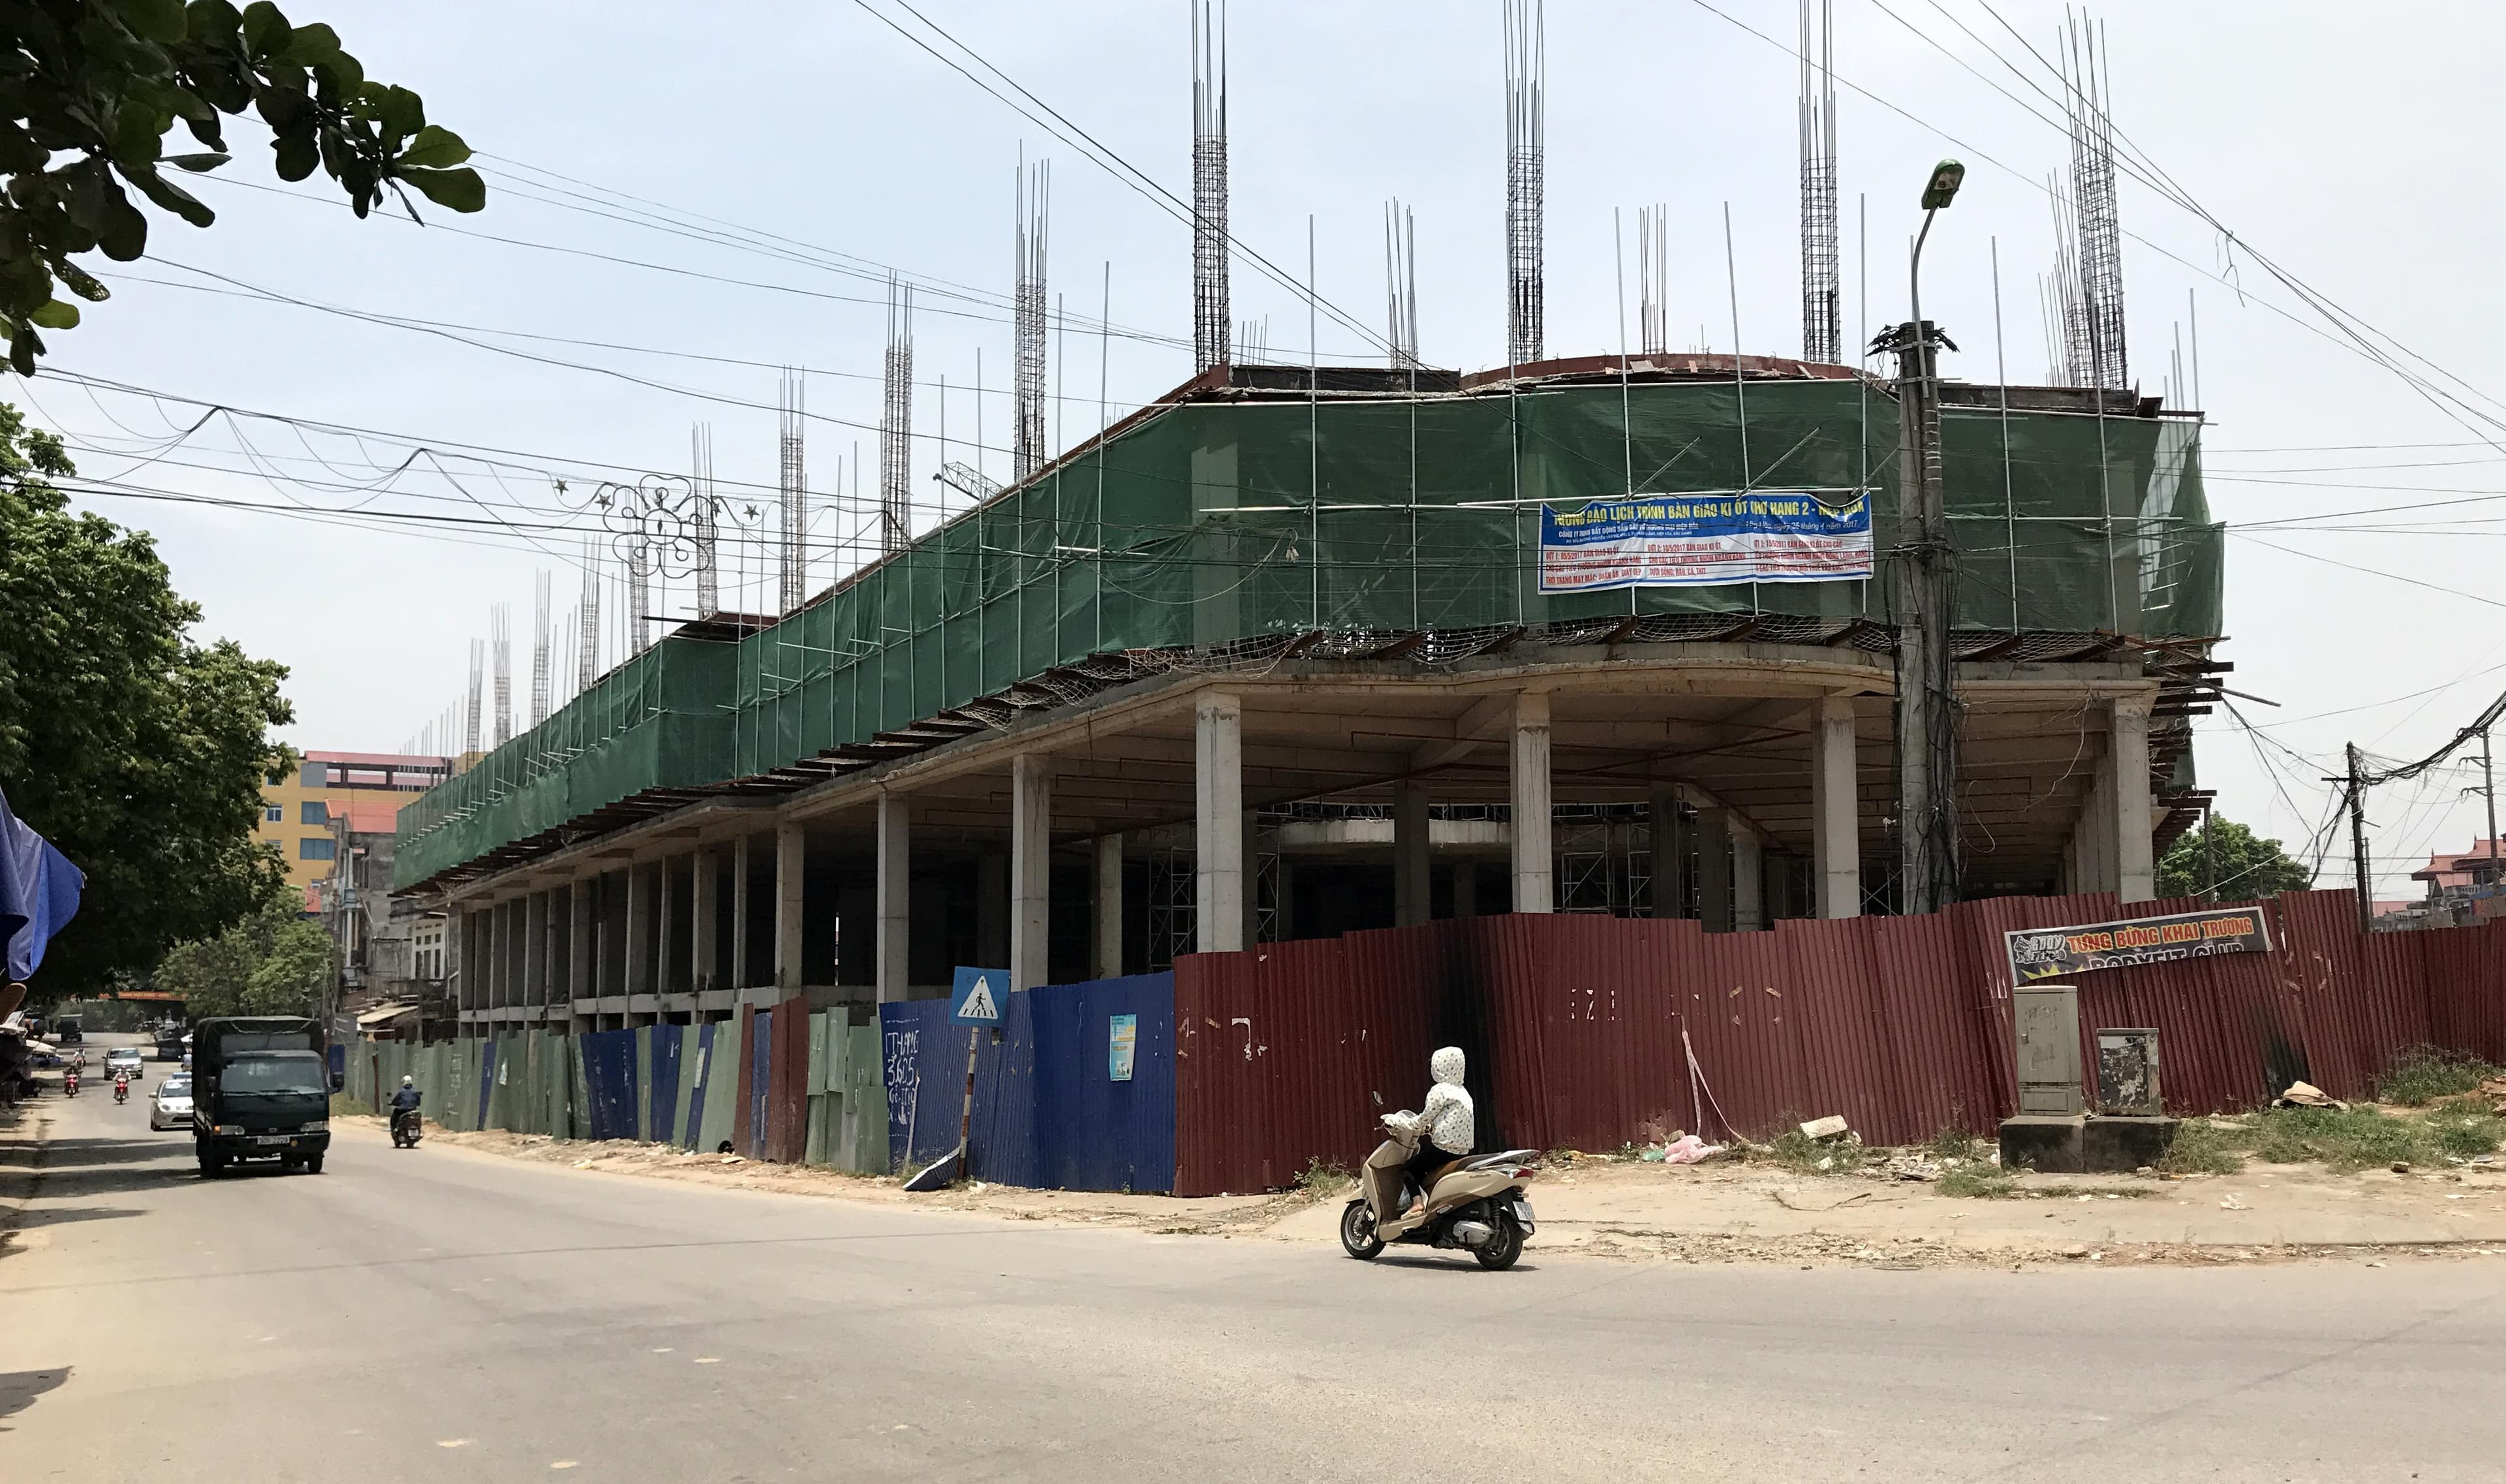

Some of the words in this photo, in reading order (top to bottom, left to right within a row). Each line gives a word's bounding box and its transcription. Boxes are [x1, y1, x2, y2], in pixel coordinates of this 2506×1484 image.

[1610, 506, 1633, 523] LỊCH
[1694, 502, 1718, 518] GIAO
[1720, 502, 1732, 516] KI
[1802, 502, 1809, 516] 2
[2114, 925, 2161, 950] BỪNG
[2161, 921, 2201, 944] KHAI
